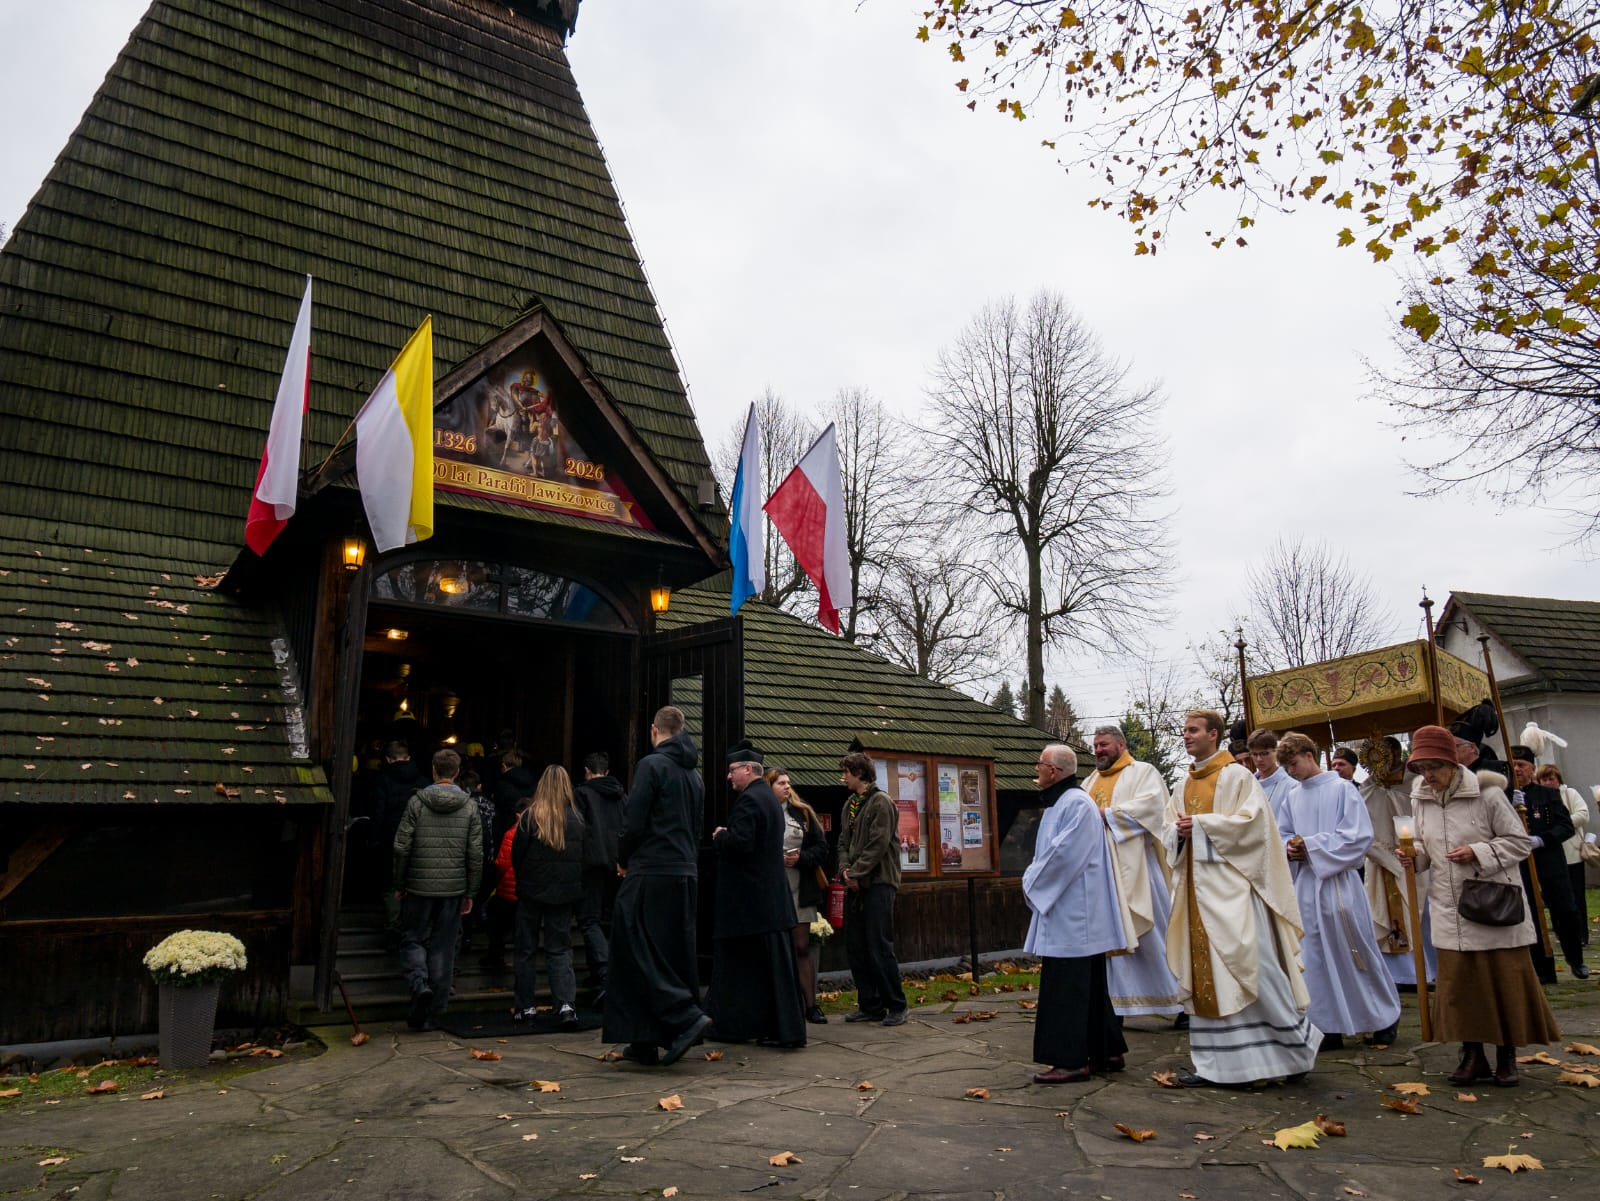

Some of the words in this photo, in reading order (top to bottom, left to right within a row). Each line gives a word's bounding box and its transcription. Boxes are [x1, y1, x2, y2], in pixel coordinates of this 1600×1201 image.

[435, 429, 476, 454] 1326
[565, 458, 604, 480] 2026
[451, 465, 471, 483] lat
[477, 471, 526, 493] Parafii
[527, 482, 615, 511] Jawiszowice
